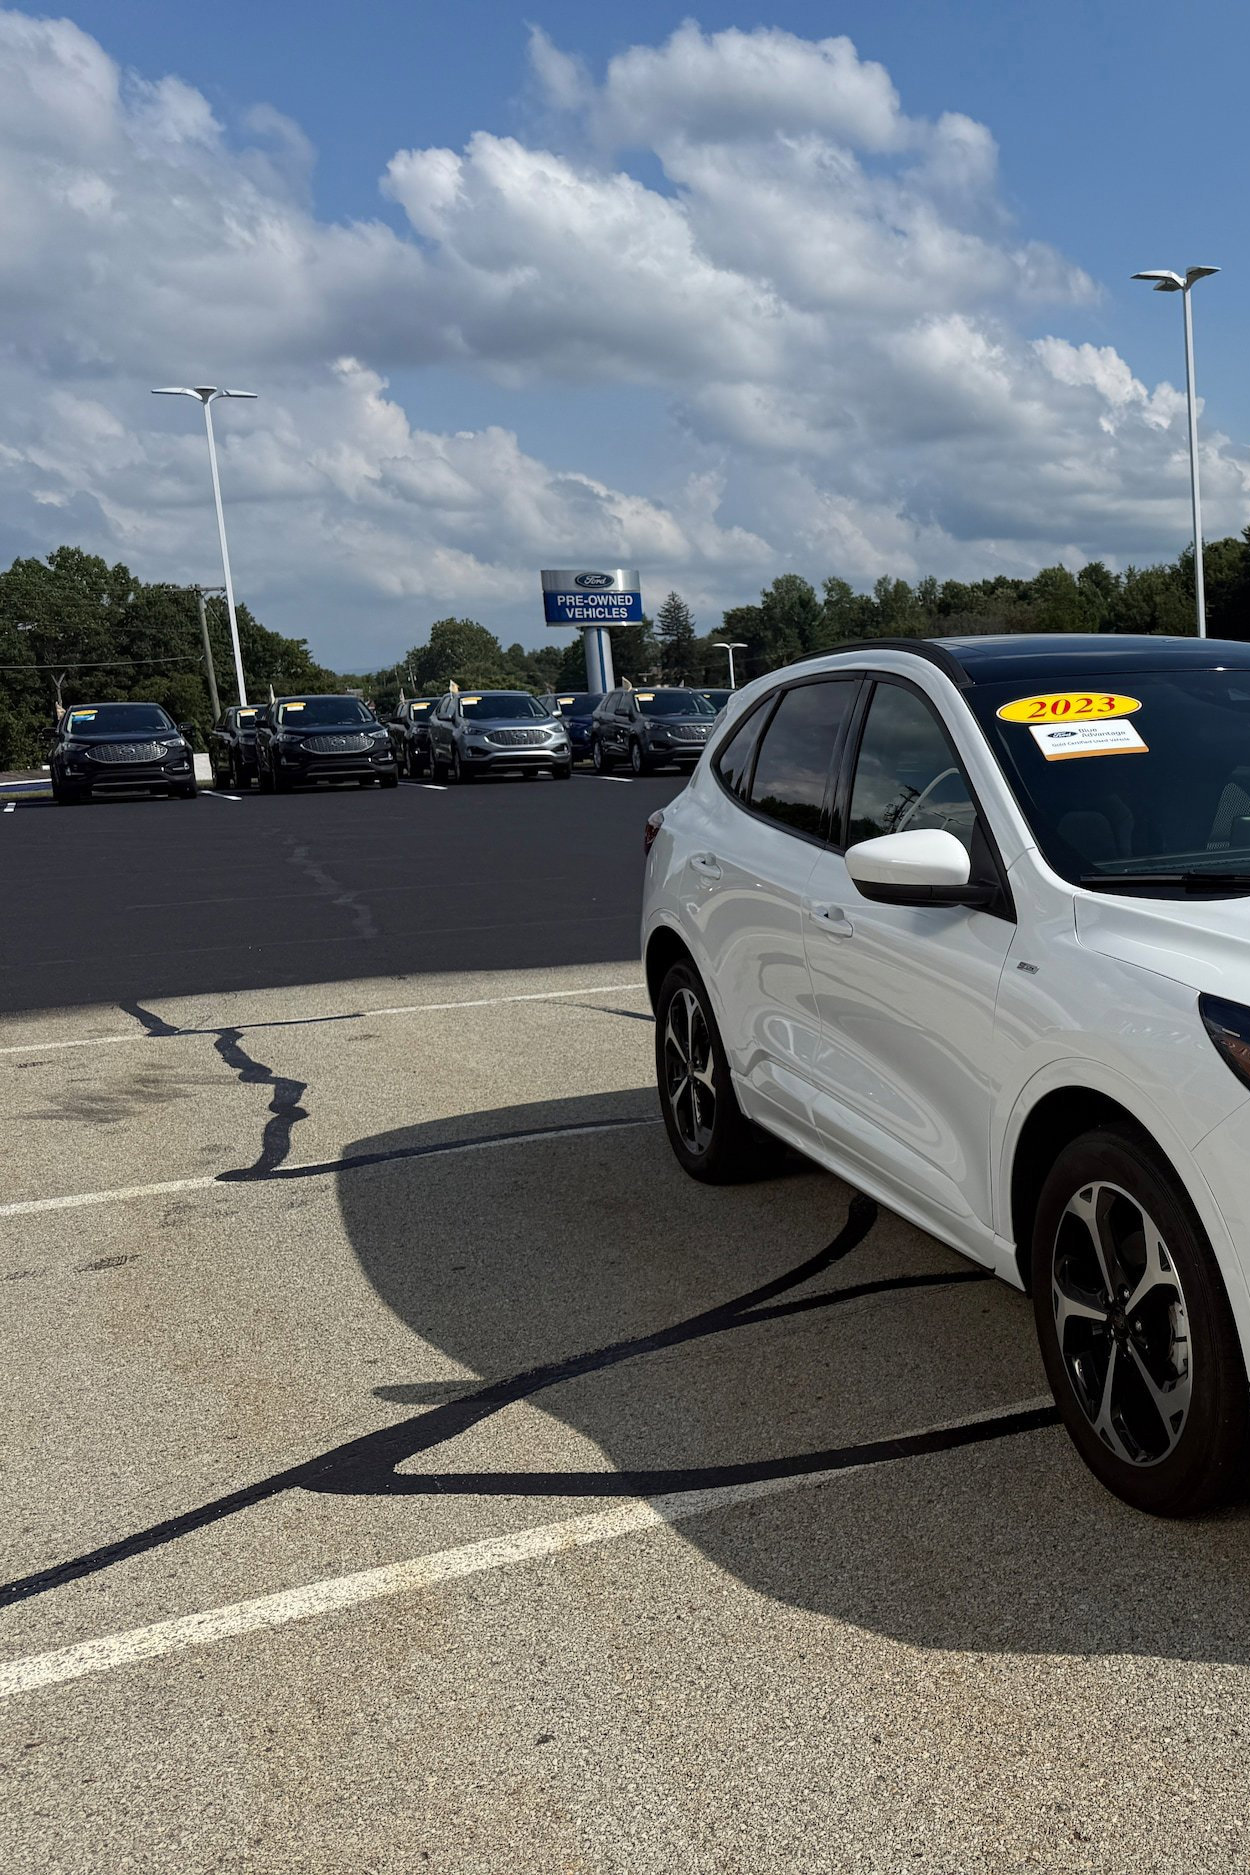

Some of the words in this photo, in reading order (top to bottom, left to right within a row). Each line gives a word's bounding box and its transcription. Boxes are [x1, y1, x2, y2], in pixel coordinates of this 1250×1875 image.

[557, 594, 633, 606] PRE-OWNED
[566, 607, 628, 619] VEHICLES
[1027, 696, 1116, 719] 2023
[1081, 730, 1126, 738] Advantage
